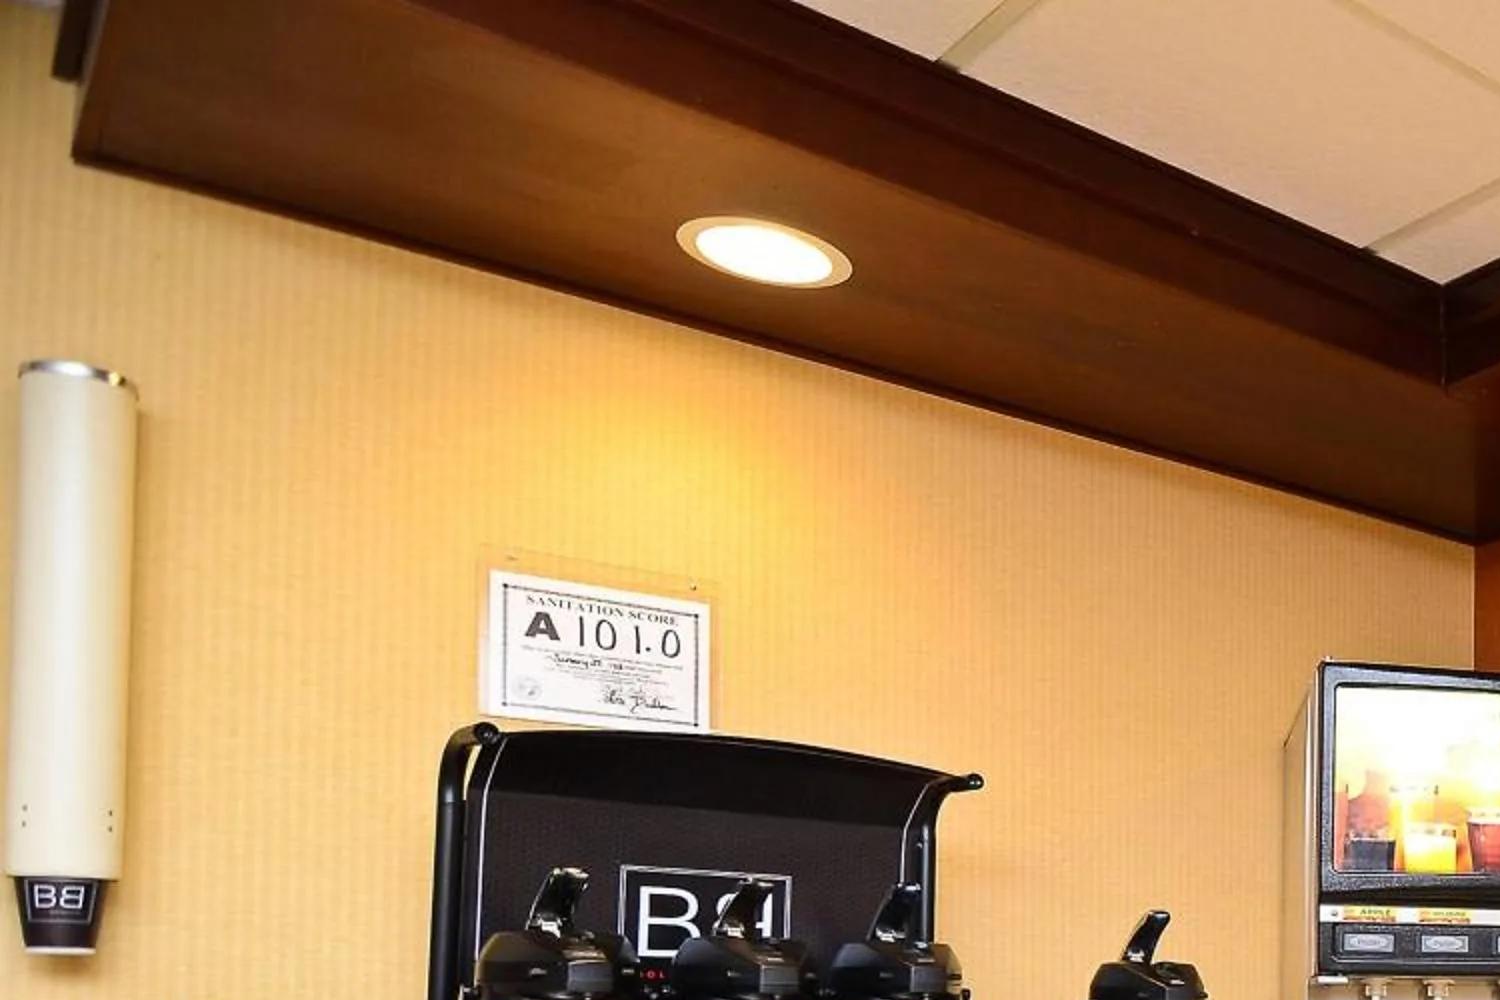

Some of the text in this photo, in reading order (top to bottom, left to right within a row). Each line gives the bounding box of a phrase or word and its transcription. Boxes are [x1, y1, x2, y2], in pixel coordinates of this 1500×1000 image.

[526, 594, 679, 626] SANITATION SCORE
[525, 611, 561, 641] A
[34, 884, 85, 909] BB
